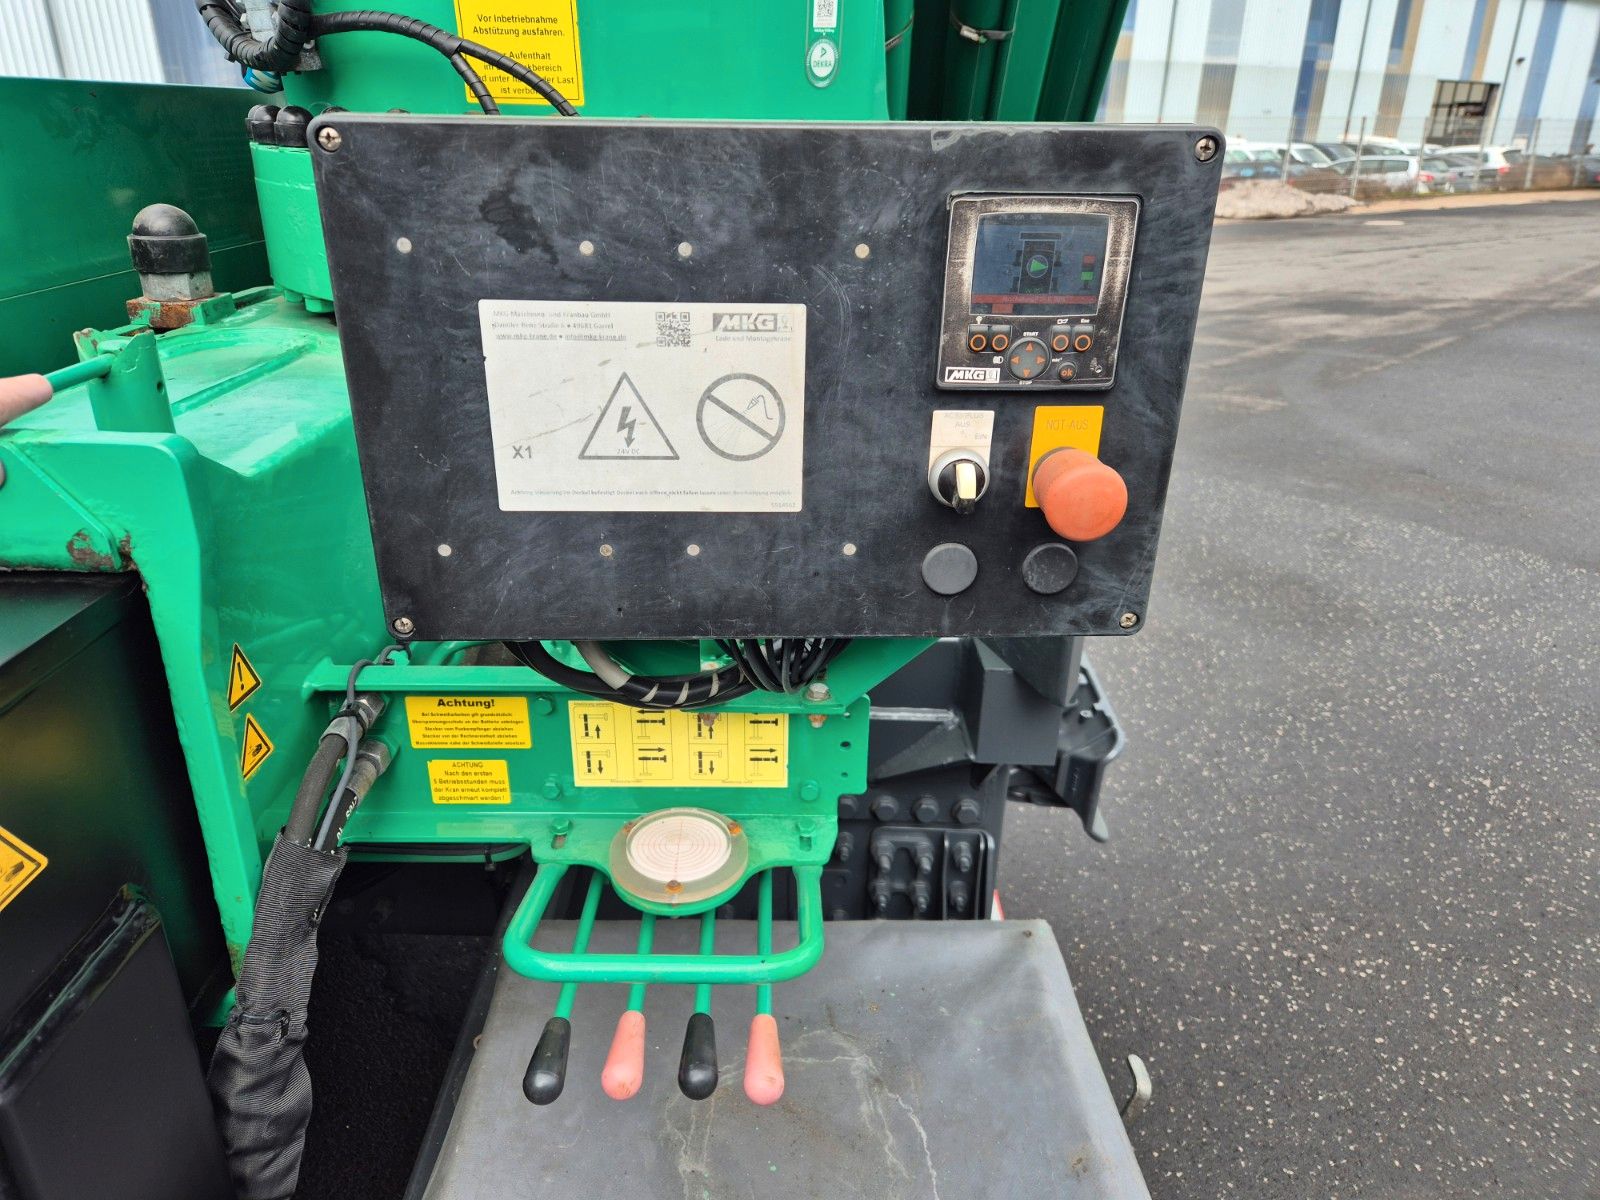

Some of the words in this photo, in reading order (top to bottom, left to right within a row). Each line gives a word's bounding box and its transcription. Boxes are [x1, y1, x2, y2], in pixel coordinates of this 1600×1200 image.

[477, 14, 492, 23] Vor
[494, 15, 558, 24] Inbetriebnahme
[473, 26, 520, 37] Abstützung
[522, 28, 565, 37] ausfahren.
[509, 51, 551, 61] Aufenthalt
[813, 59, 832, 68] DEKRA
[489, 76, 510, 84] unter
[557, 76, 575, 85] Last
[500, 86, 510, 94] ist
[715, 312, 776, 332] MKG
[948, 368, 985, 381] MKG
[1061, 367, 1073, 376] ok
[512, 445, 532, 459] X1
[437, 698, 496, 709] Achtung!
[452, 761, 483, 769] ACHTUNG
[482, 787, 508, 795] komplett
